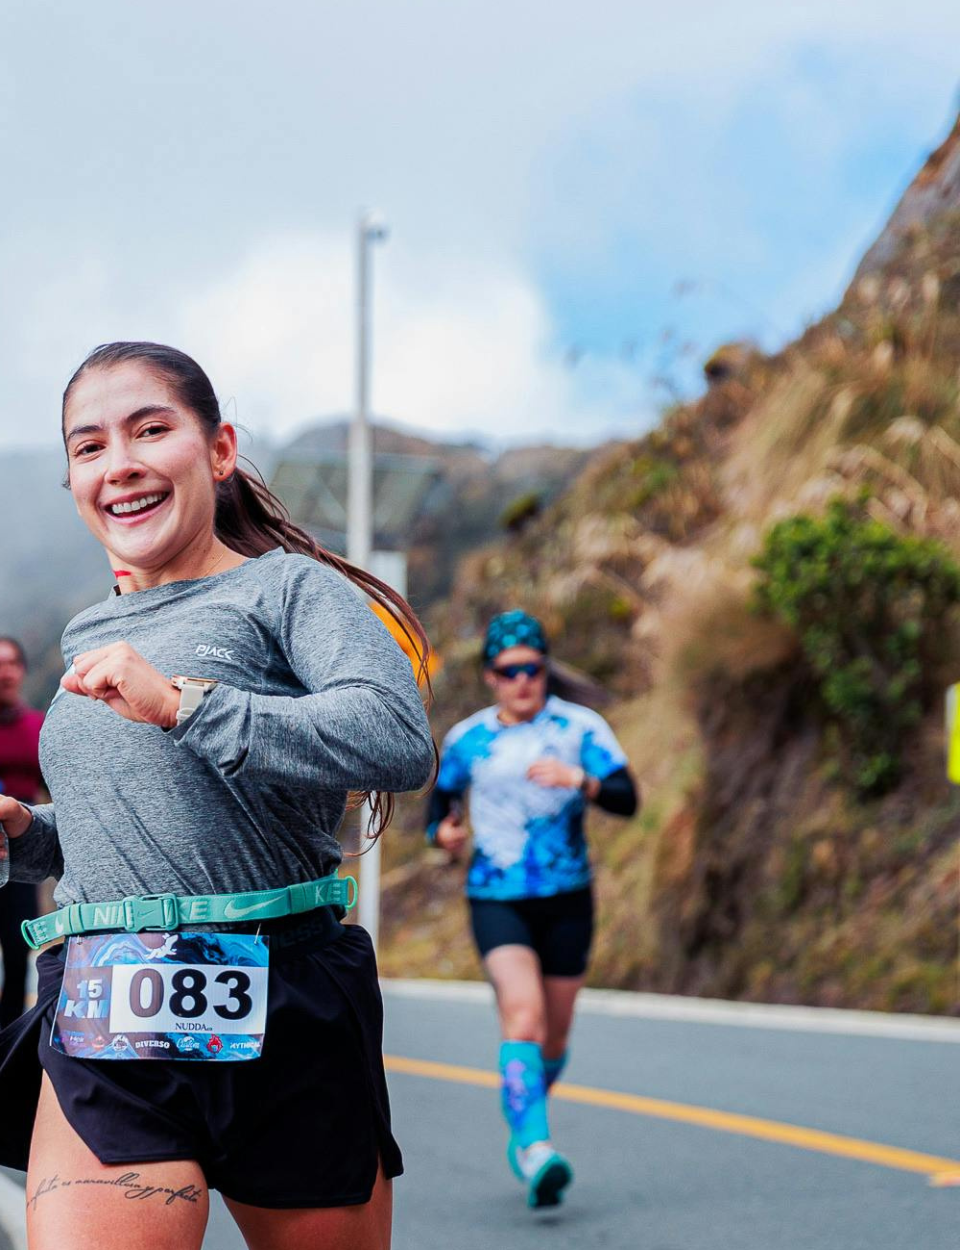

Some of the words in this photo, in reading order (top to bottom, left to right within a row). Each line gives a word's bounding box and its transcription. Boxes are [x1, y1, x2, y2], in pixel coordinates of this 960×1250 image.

[77, 979, 103, 999] 15
[129, 967, 253, 1020] 083
[63, 1000, 108, 1019] KM
[135, 1040, 170, 1049] DIVERSO
